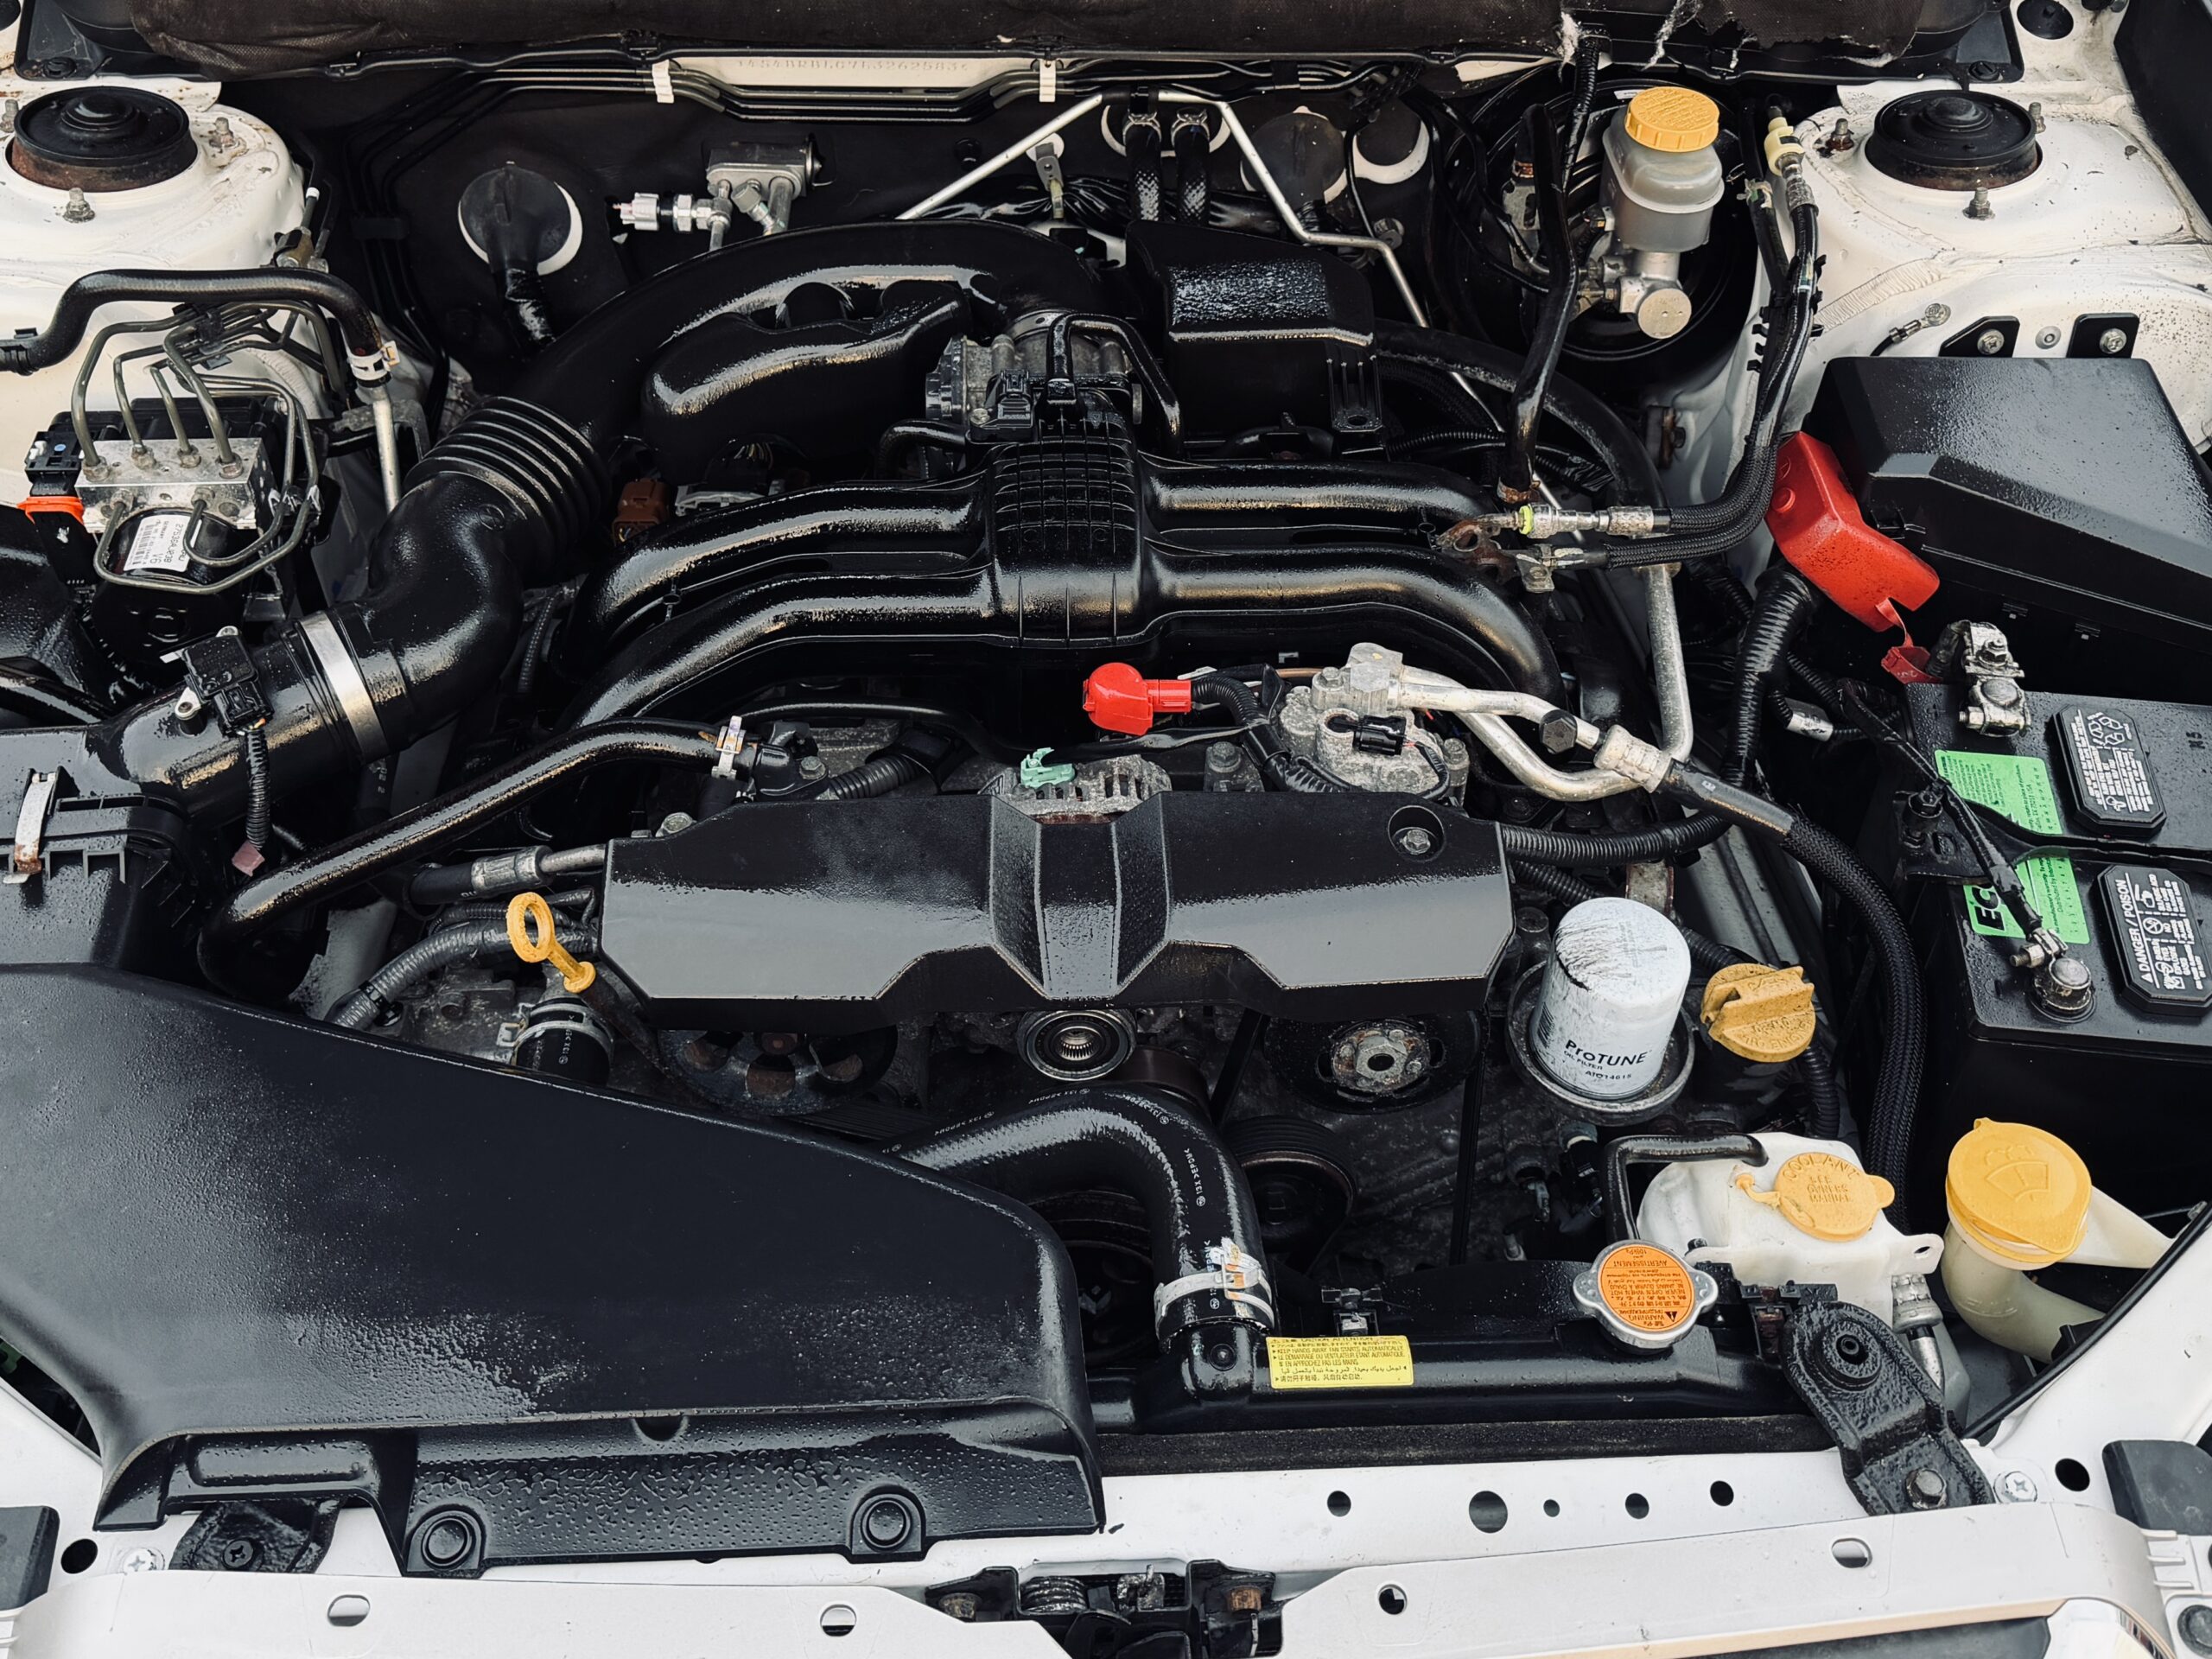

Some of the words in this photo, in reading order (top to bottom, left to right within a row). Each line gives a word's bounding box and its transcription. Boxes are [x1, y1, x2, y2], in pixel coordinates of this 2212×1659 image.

[2116, 879, 2136, 918] POISON
[2129, 929, 2152, 972] DANGER
[1564, 1051, 1575, 1061] OIL
[1577, 1058, 1603, 1070] FILTER
[1783, 1154, 1859, 1181] COOLANT
